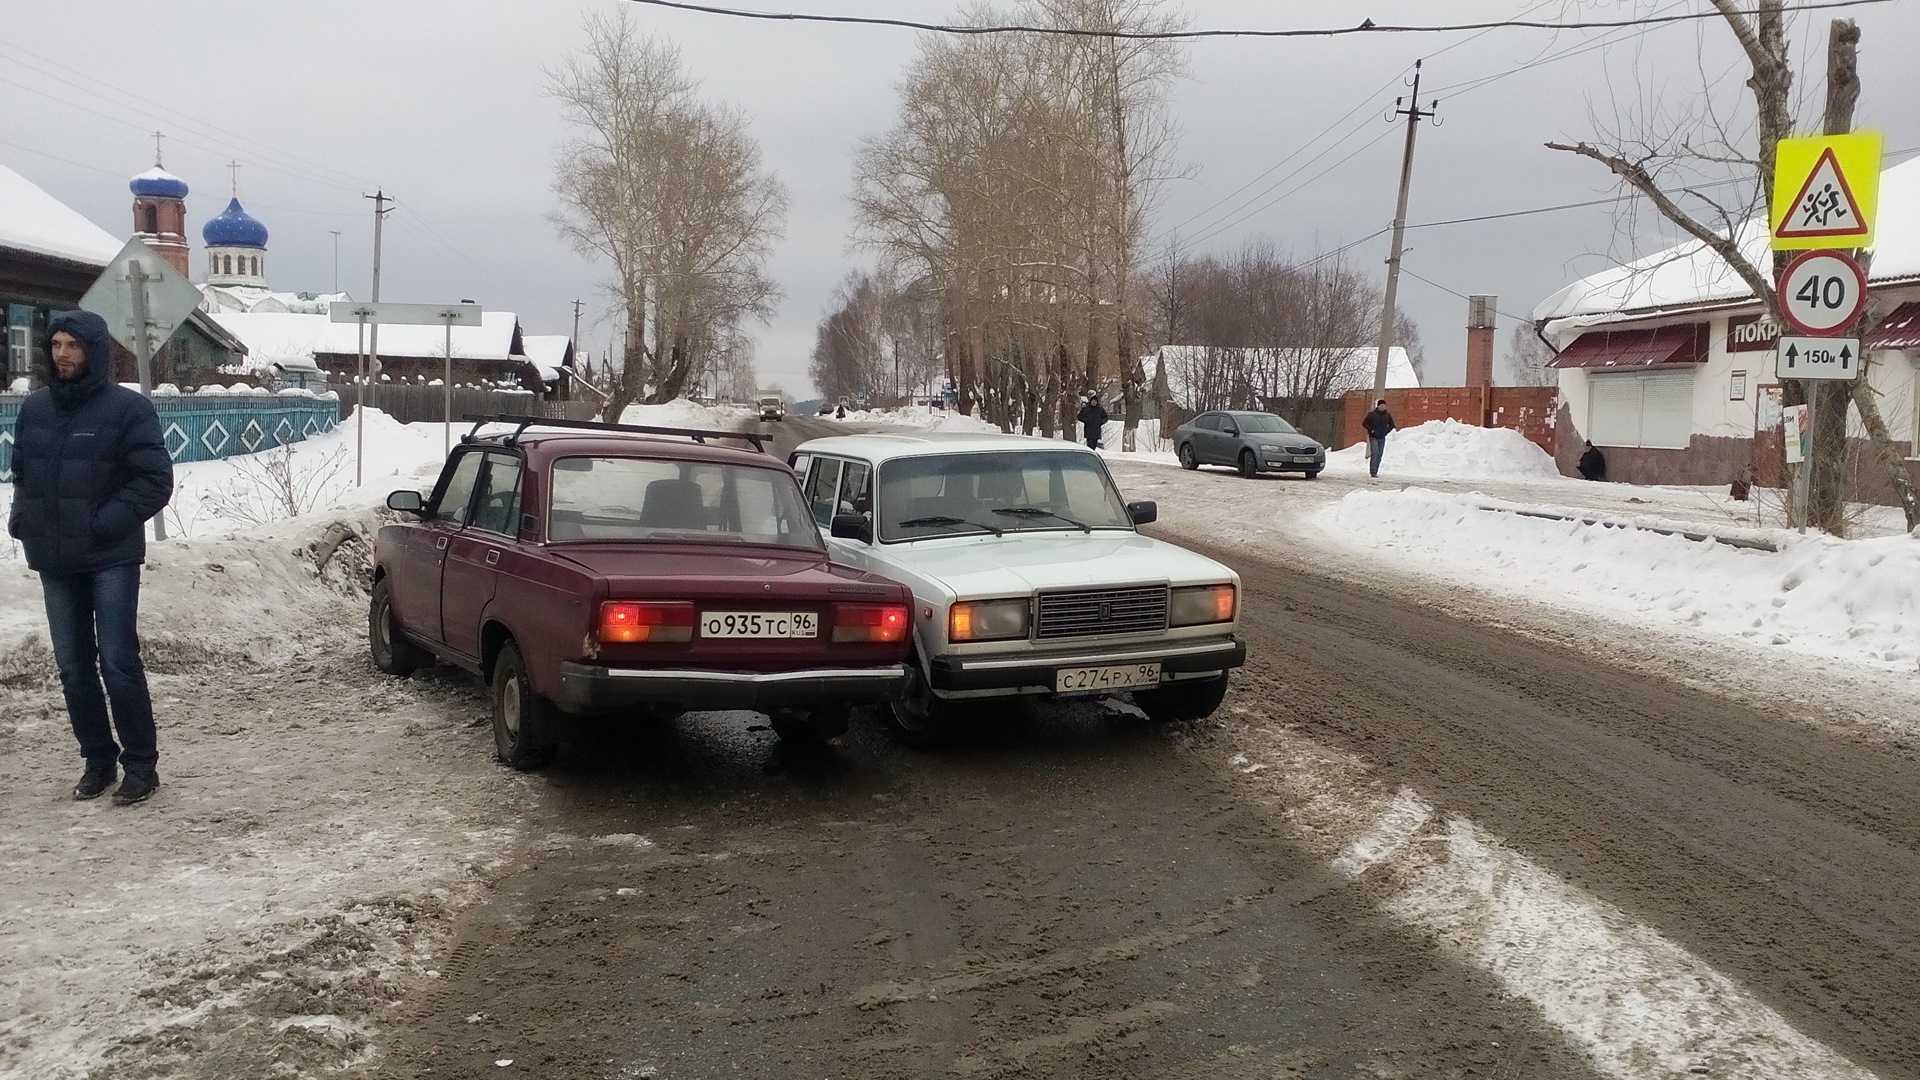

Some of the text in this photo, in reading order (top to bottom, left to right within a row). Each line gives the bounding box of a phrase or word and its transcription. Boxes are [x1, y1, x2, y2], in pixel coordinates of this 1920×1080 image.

[1795, 275, 1845, 309] 40
[793, 614, 811, 630] 96
[1139, 665, 1154, 678] 96
